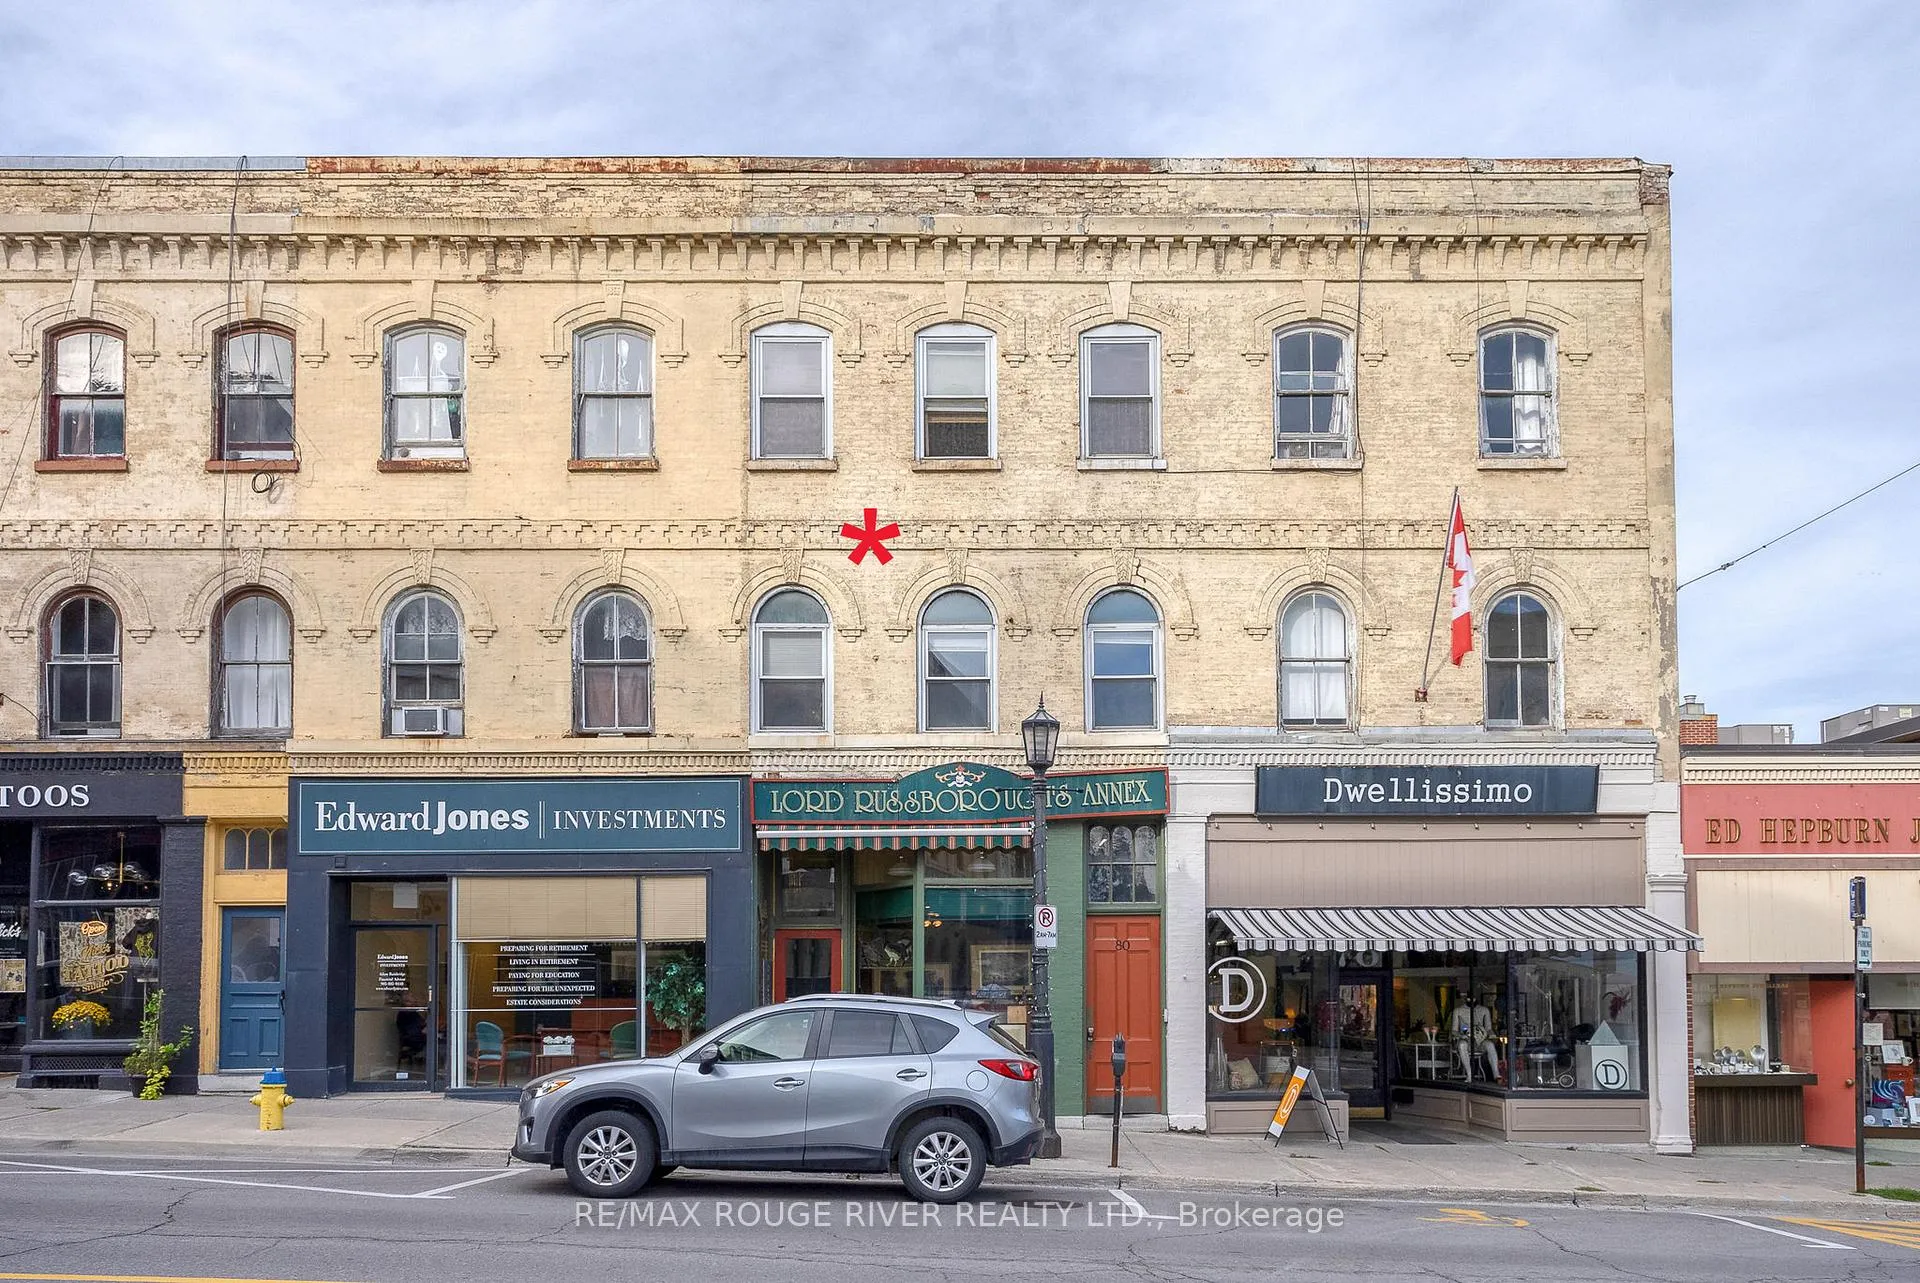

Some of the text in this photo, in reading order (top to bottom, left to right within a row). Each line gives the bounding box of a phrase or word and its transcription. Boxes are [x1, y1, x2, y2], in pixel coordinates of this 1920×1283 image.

[770, 790, 844, 814] LORD
[1082, 779, 1153, 806] ANNEX
[1323, 778, 1533, 803] Dwellissimo
[553, 807, 727, 831] INVESTMENTS
[1704, 818, 1742, 843] ED
[1759, 818, 1891, 843] HEPBURN
[1115, 940, 1131, 952] 80
[528, 998, 582, 1006] CONSIDERATIONS
